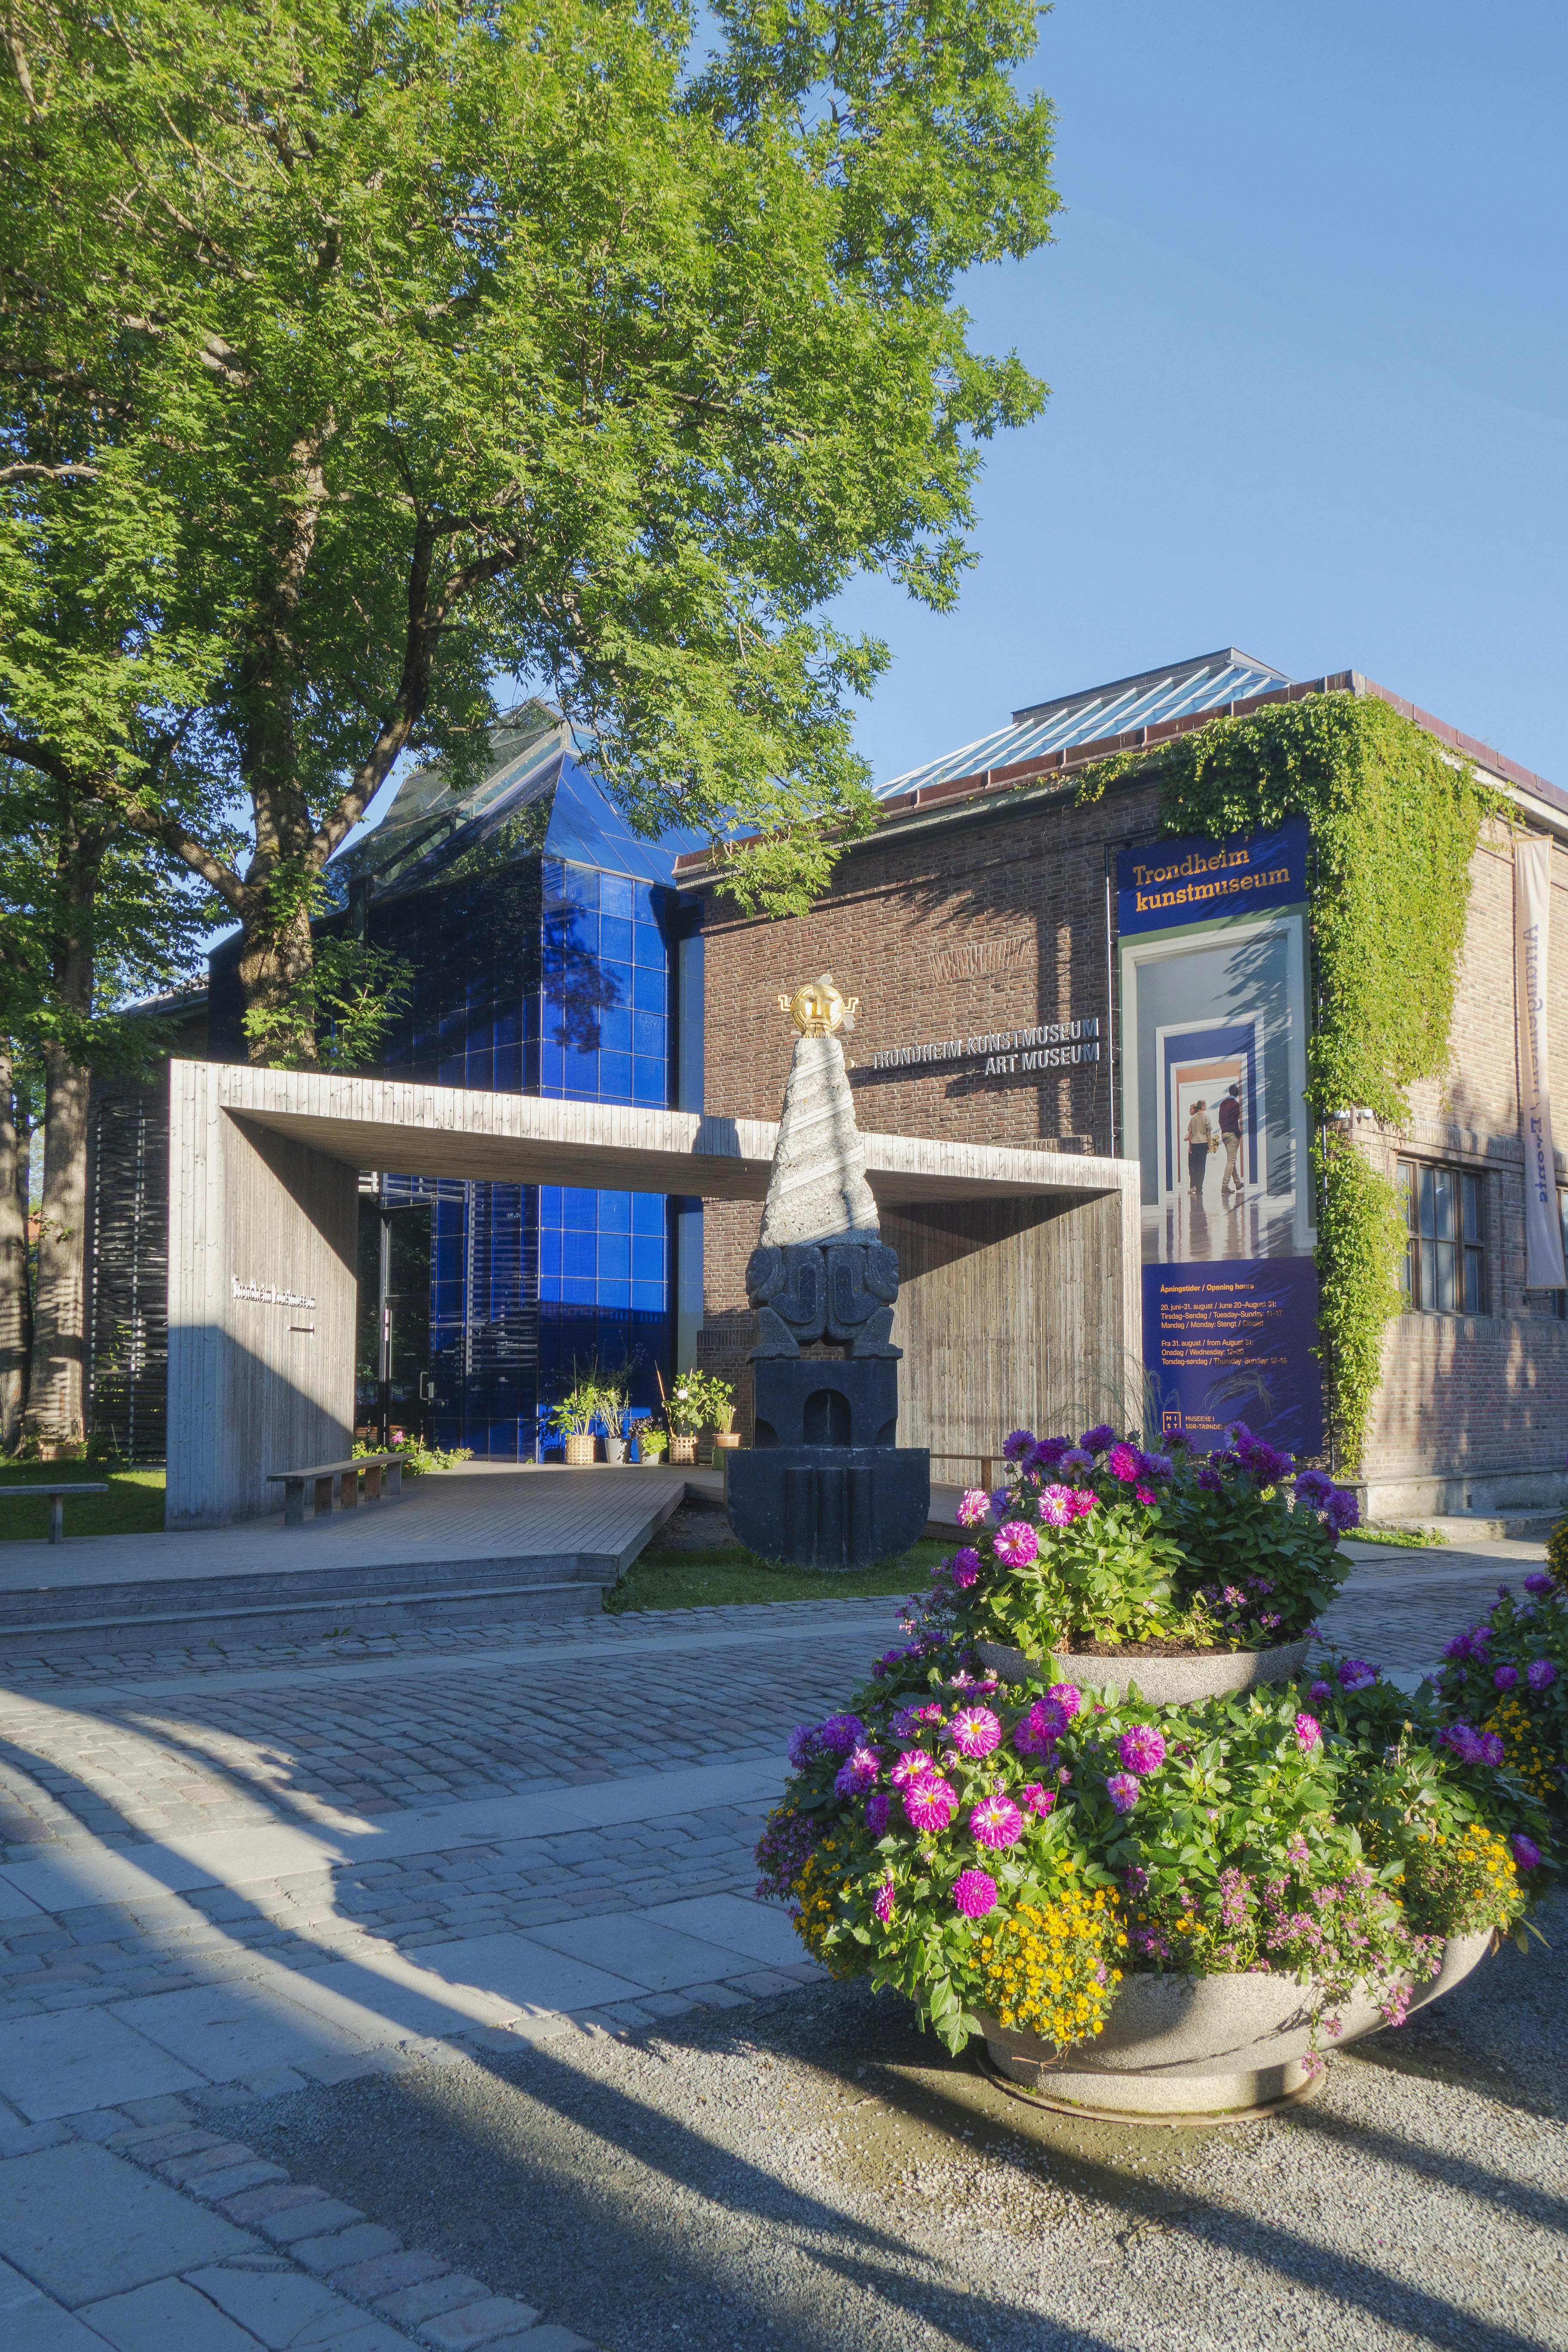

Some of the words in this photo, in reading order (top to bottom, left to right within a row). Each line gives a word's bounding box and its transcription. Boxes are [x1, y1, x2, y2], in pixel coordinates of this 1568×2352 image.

[1133, 850, 1250, 886] Trondheim
[1136, 868, 1290, 912] kunstmuseum
[873, 1039, 963, 1069] TRONDHEIM
[967, 1018, 1099, 1055] KUNSTMUSEUM
[985, 1054, 1018, 1075] ART
[1022, 1042, 1099, 1070] MUSEUM
[233, 1277, 272, 1303] Trondheim
[1161, 1284, 1200, 1294] Åpningstider
[1207, 1283, 1234, 1292] Opening
